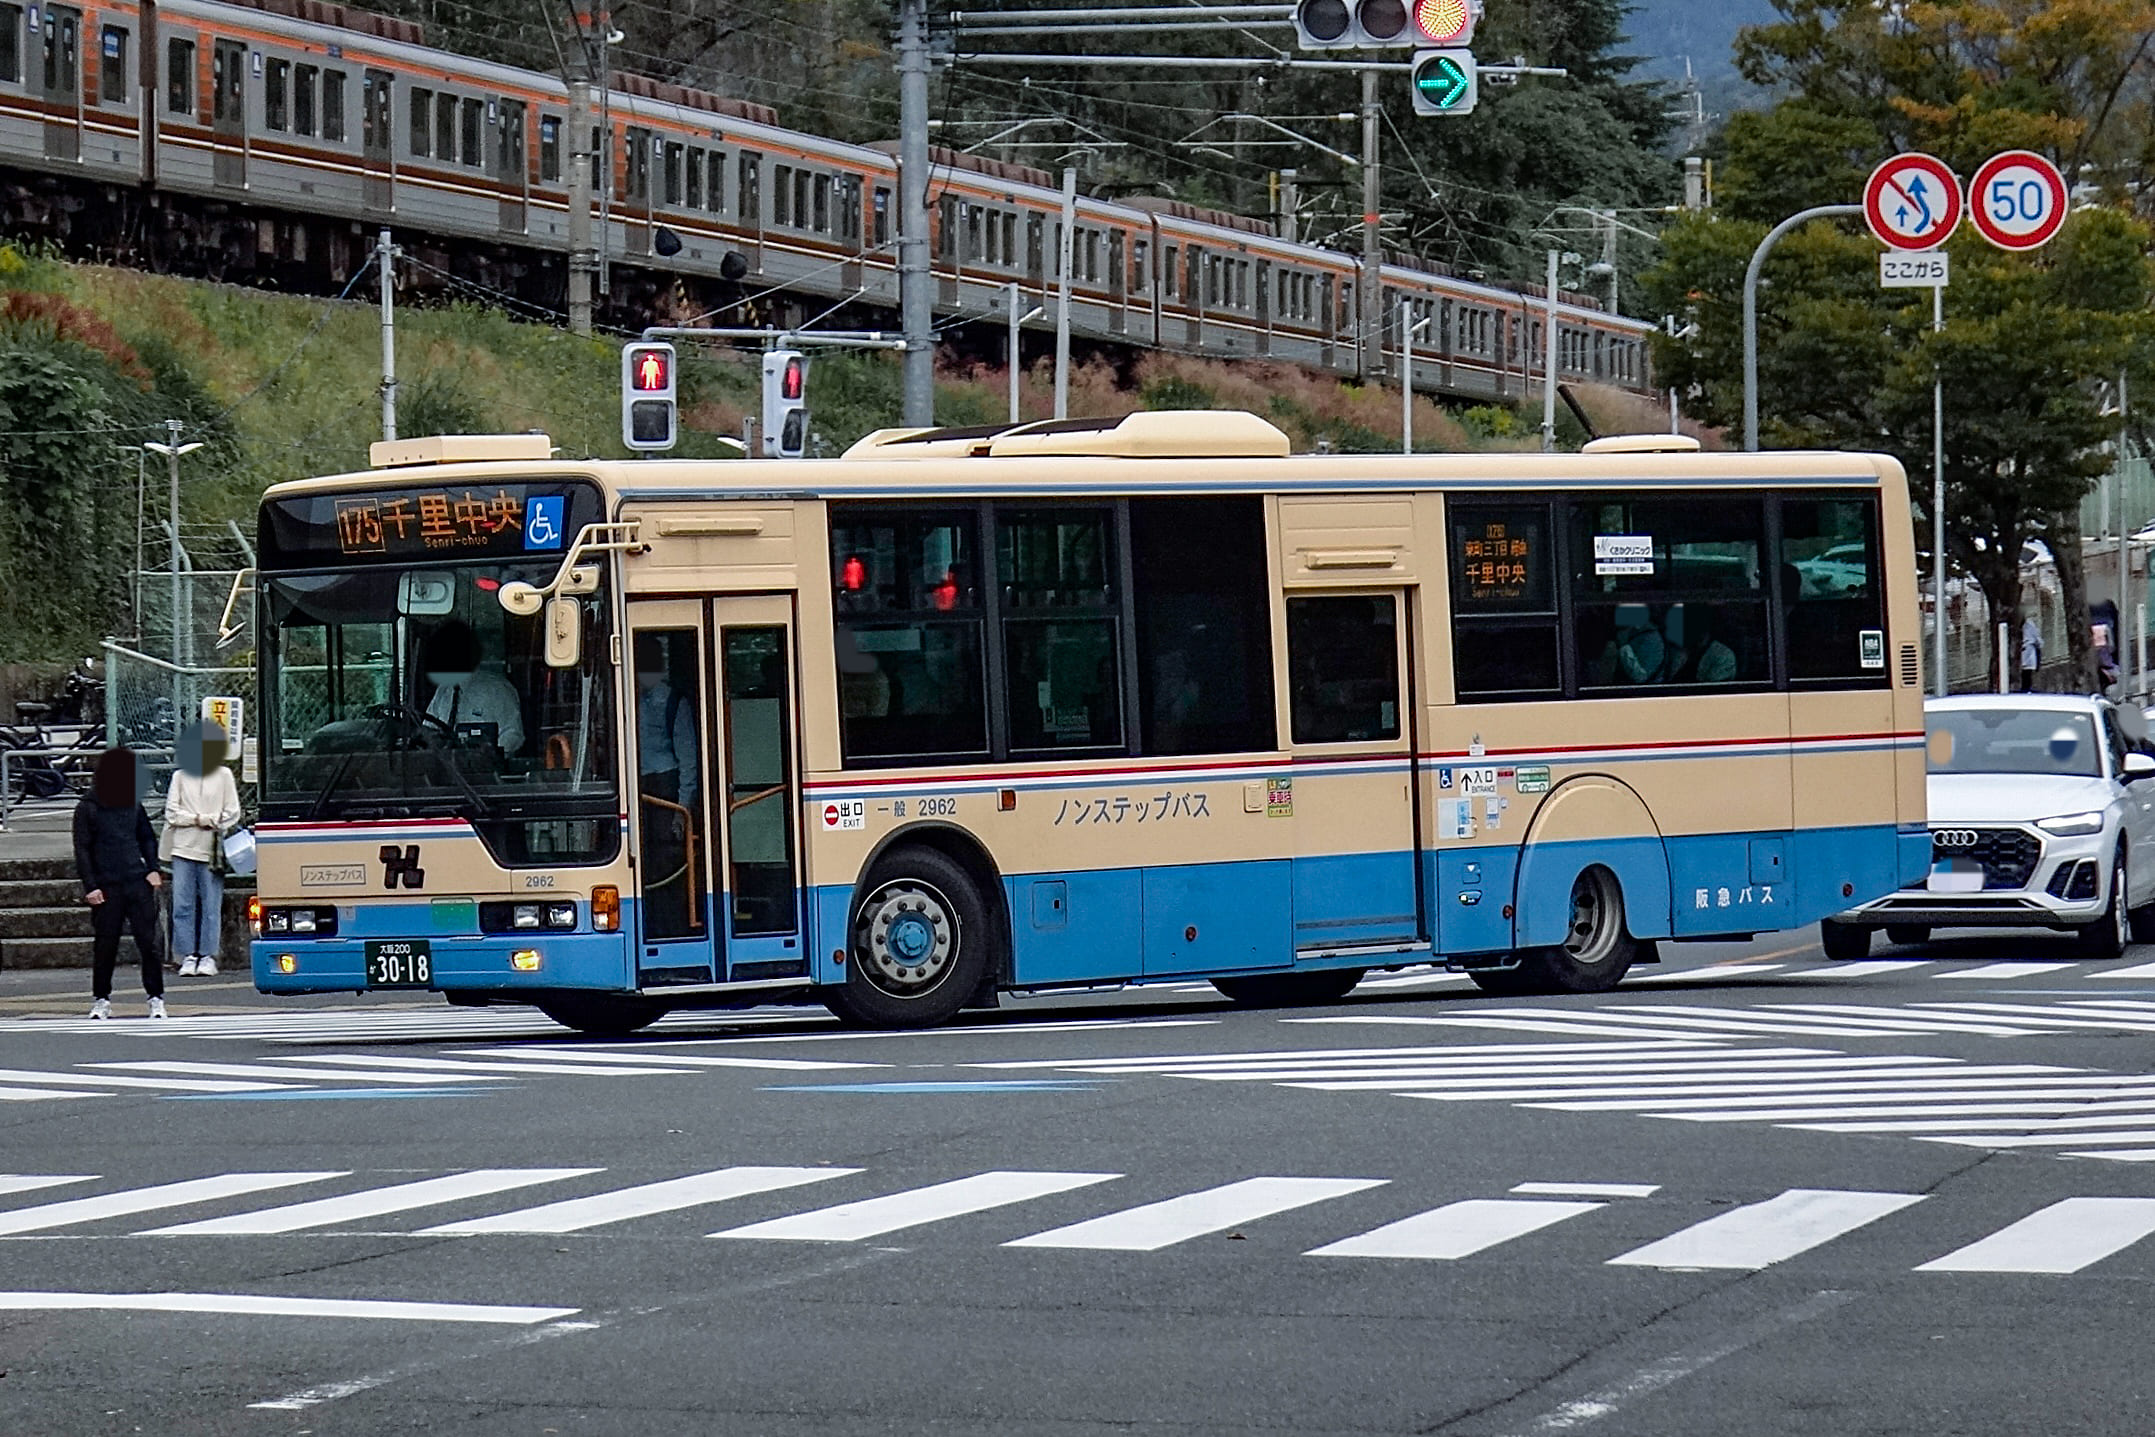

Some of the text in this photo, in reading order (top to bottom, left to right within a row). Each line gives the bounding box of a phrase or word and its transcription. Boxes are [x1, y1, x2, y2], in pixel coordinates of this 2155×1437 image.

[1993, 181, 2043, 221] 50
[1884, 261, 1944, 279] ここから
[340, 489, 522, 544] 175 千里中央
[1465, 561, 1526, 585] 千里中央
[1474, 770, 1493, 784] 入口
[840, 802, 863, 817] 出口
[877, 798, 957, 817] 一般 2962
[1054, 791, 1210, 826] ノンステップバス
[843, 818, 860, 828] EXIT
[303, 870, 363, 881] ノンステップバス
[525, 875, 555, 887] 2962
[1695, 886, 1774, 909] 阪急バス
